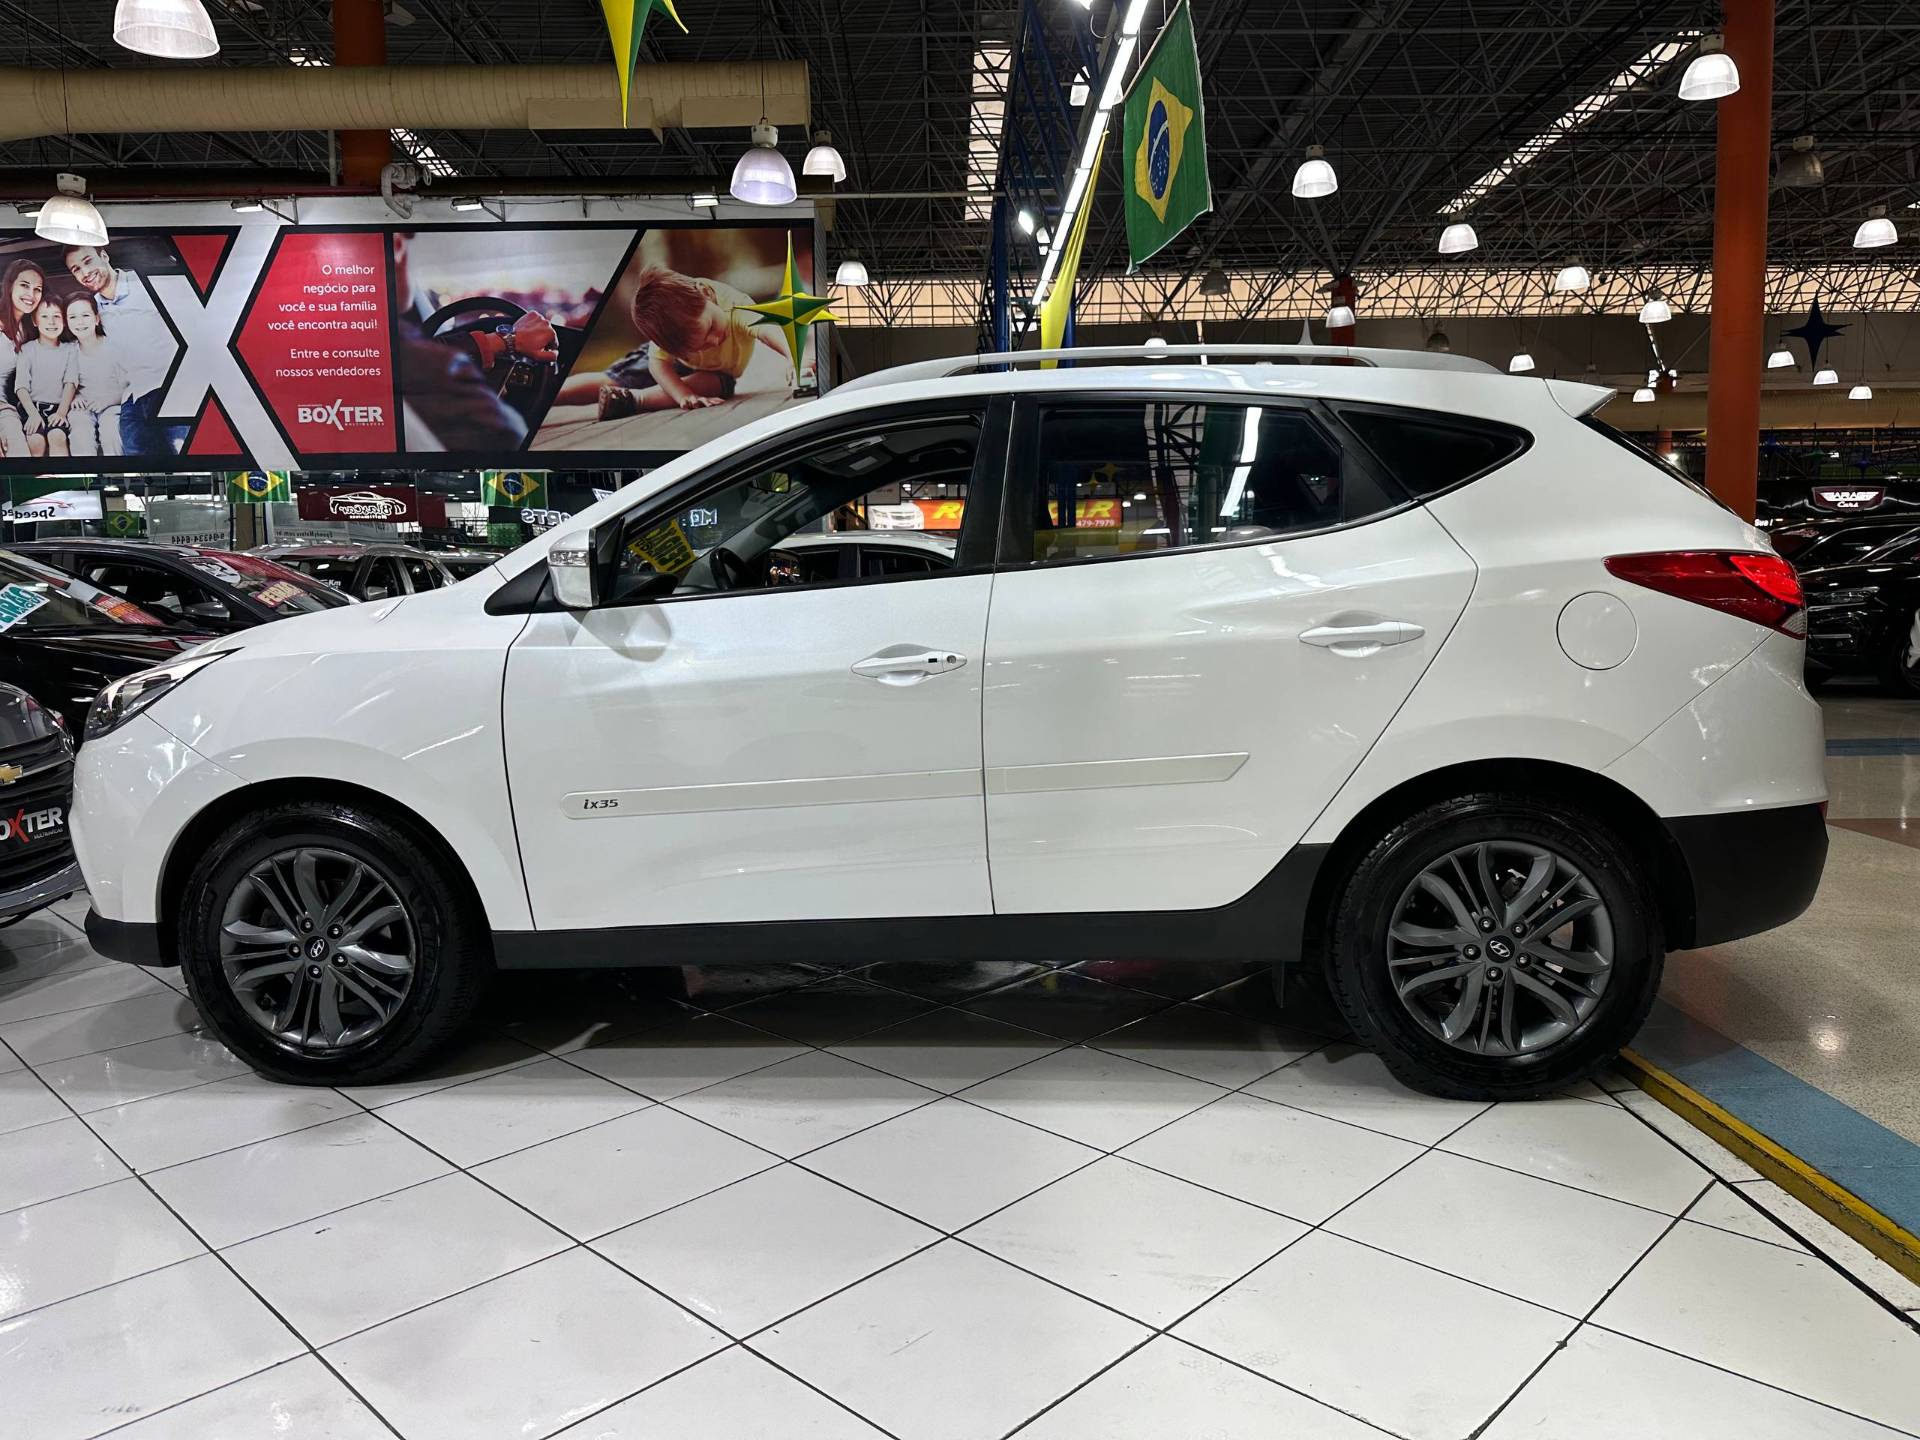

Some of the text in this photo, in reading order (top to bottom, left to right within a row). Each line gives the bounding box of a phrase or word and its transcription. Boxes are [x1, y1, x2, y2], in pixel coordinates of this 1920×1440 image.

[321, 264, 375, 275] O melhor
[303, 283, 376, 295] negócio para
[279, 301, 377, 312] você e sua família
[268, 319, 378, 331] você encontra aqui!
[290, 348, 380, 358] Entre e consulte
[275, 366, 381, 377] nossos vendedores
[297, 399, 384, 431] BOXTER
[583, 798, 618, 810] ix35
[0, 807, 63, 842] OXTER
